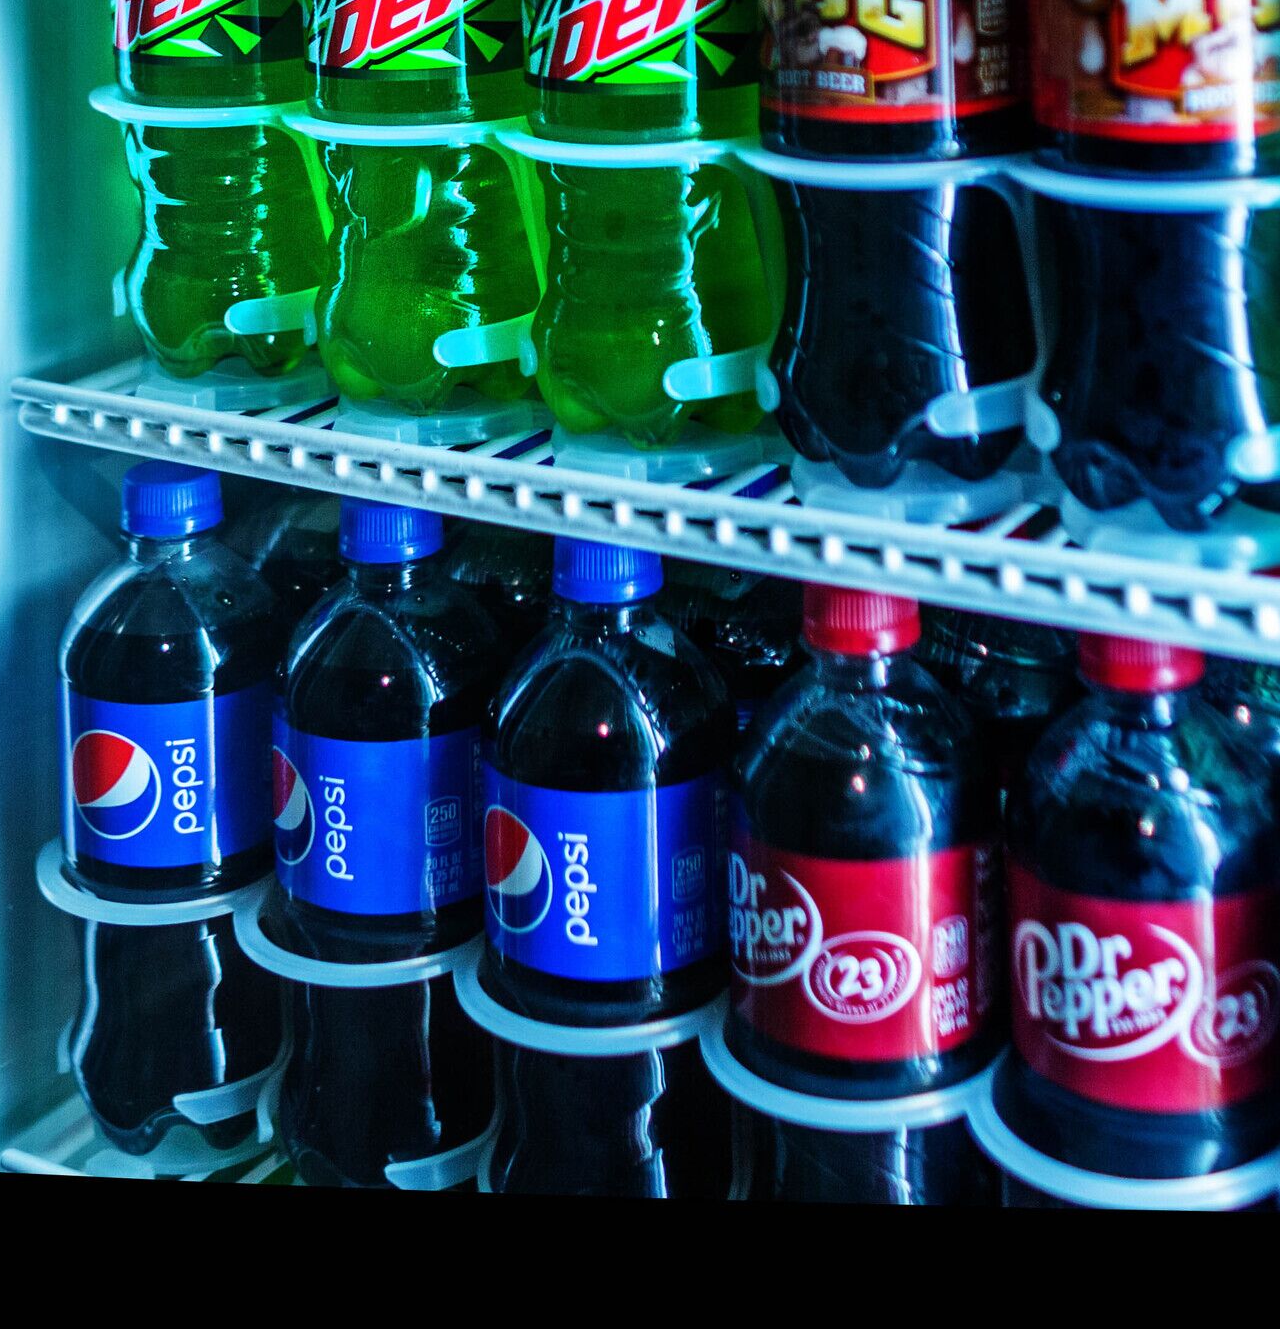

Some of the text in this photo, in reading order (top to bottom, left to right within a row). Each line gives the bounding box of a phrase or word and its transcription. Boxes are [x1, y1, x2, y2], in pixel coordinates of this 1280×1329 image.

[166, 738, 205, 834] pepsi
[319, 775, 354, 881] pepsi
[430, 803, 456, 823] 250
[557, 831, 598, 946] pepsi
[838, 955, 883, 1000] 23
[1015, 920, 1186, 1040] Pepper
[1057, 922, 1132, 979] Dr
